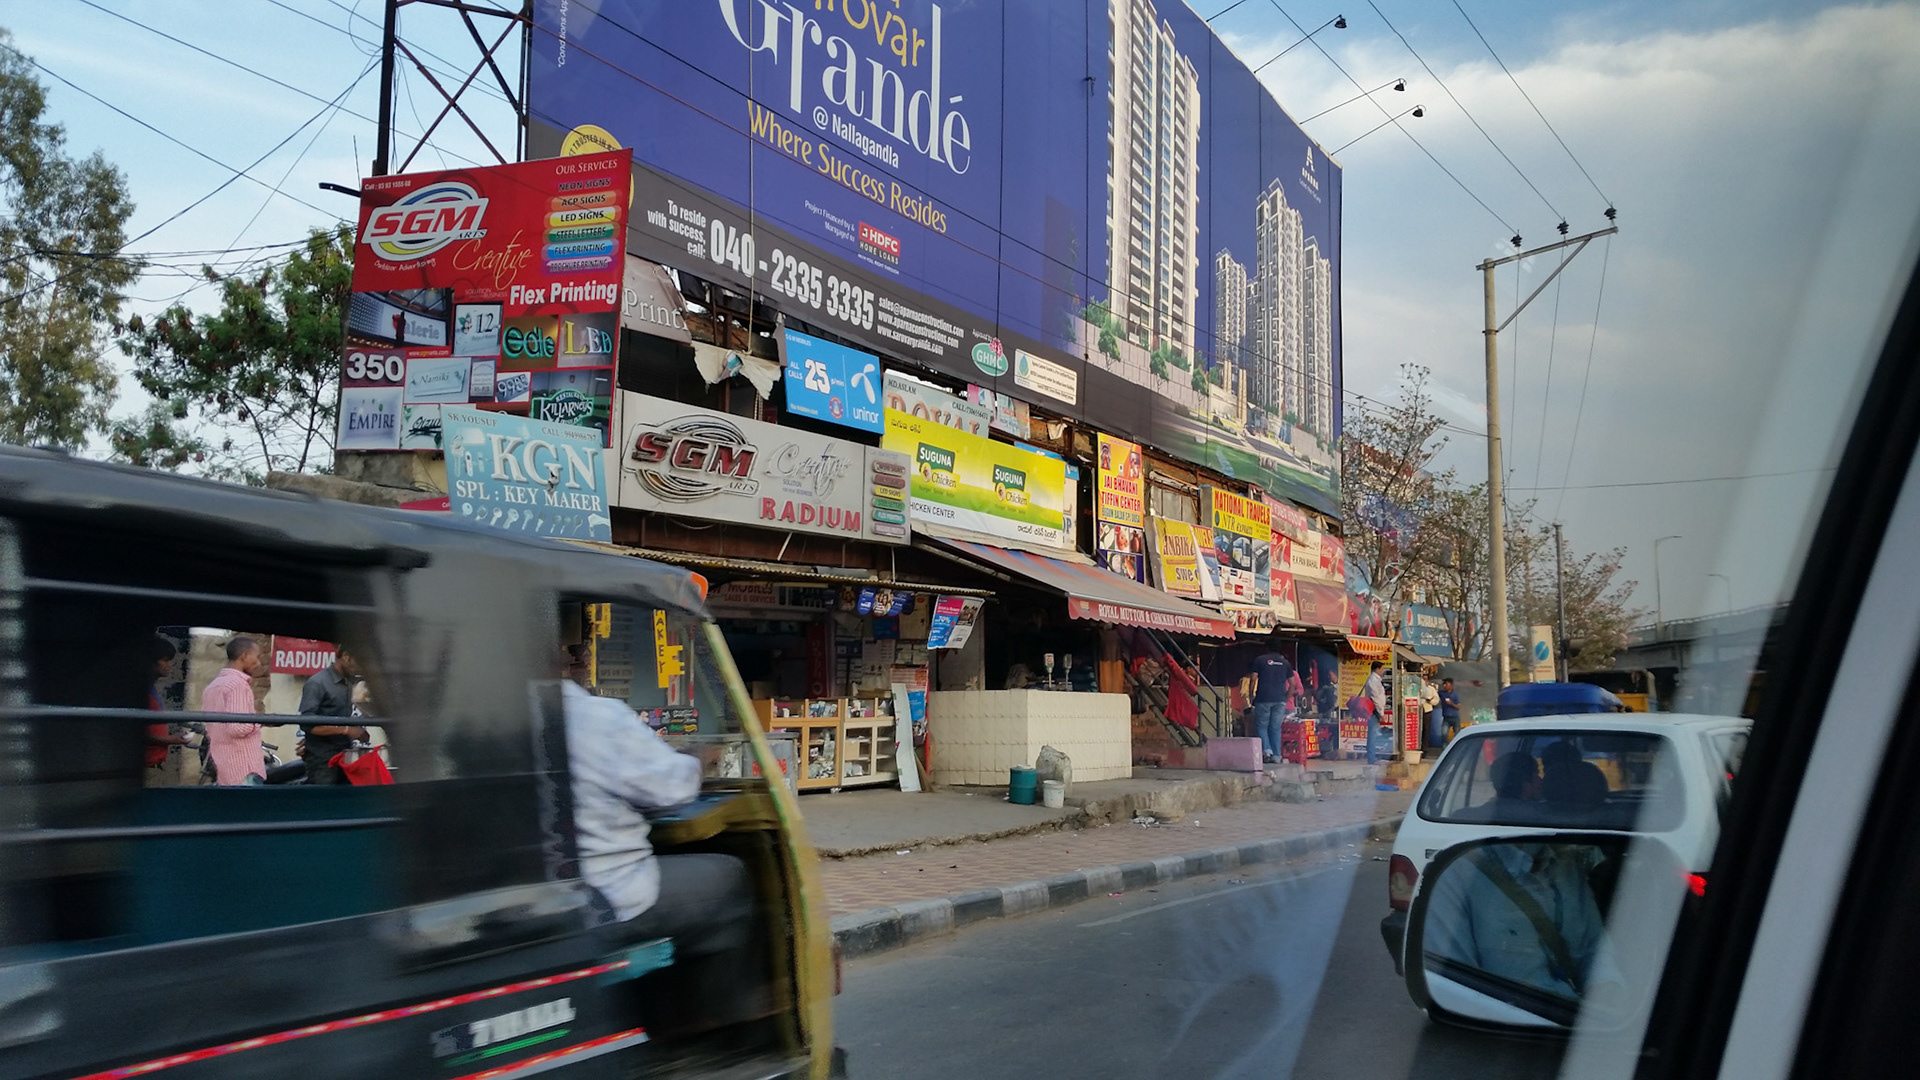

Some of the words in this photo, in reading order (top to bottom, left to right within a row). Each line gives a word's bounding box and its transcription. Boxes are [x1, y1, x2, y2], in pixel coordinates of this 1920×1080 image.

[812, 105, 829, 129] @
[831, 114, 899, 169] Nallagandla
[555, 165, 576, 175] OUR
[578, 159, 618, 173] SERVICES
[747, 99, 812, 165] Where
[817, 143, 885, 204] Success
[891, 182, 947, 234] Resides
[558, 182, 583, 191] NEON
[584, 178, 611, 189] SIGNS
[562, 197, 579, 206] ACP
[580, 195, 606, 204] SIGNS
[371, 205, 480, 238] SGM
[560, 213, 577, 222] LED
[578, 211, 604, 220] SIGNS
[667, 199, 678, 217] To
[679, 206, 706, 228] reside
[804, 199, 822, 217] Project
[823, 209, 843, 227] Financed
[556, 230, 576, 240] STEEL
[576, 227, 606, 238] LETTERS
[647, 209, 667, 229] with
[668, 218, 706, 246] success,
[554, 246, 571, 255] FLEX
[572, 243, 606, 253] PRINTING
[687, 242, 706, 259] call:
[869, 228, 899, 253] HDFC
[452, 230, 533, 290] Creative
[859, 241, 877, 256] HOME
[879, 250, 899, 265] LOANS
[710, 219, 756, 278] 040
[771, 249, 823, 310] 2335
[827, 275, 875, 331] 3335
[509, 284, 546, 305] Flex
[549, 281, 618, 305] Printing
[878, 296, 964, 338] sales@aparnaconstructions.com
[564, 320, 613, 354] LED
[878, 310, 959, 349] www.aparnaconstructions.com
[346, 352, 404, 382] 350
[790, 360, 800, 370] ALL
[976, 349, 1003, 370] GHMC
[787, 369, 803, 380] CALLS
[804, 358, 831, 395] 25
[349, 410, 396, 431] EMPIRE
[852, 406, 879, 424] uninor
[487, 432, 599, 492] KGN
[631, 431, 756, 478] SGM
[919, 446, 952, 467] SUGUNA
[726, 481, 756, 492] ARTS
[932, 471, 957, 488] Chicken
[995, 468, 1023, 486] SUGUNA
[1104, 475, 1113, 490] JAI
[1113, 477, 1138, 496] BHAVANI
[456, 479, 491, 501] SPL
[504, 484, 539, 505] KEY
[544, 489, 602, 513] MAKER
[1005, 491, 1028, 506] Chicken
[1101, 491, 1119, 508] TIFFIN
[1120, 495, 1141, 513] CENTER
[1215, 490, 1245, 518] NATIONAL
[1246, 500, 1270, 526] TRAVELS
[762, 497, 861, 532] RADIUM
[932, 506, 955, 519] CENTER
[1098, 603, 1119, 619] ROYAL
[1119, 606, 1144, 622] MUTTON
[1145, 610, 1151, 623] &
[1150, 611, 1175, 627] CHICKEN
[1175, 615, 1197, 630] CENTER
[275, 650, 336, 669] RADIUM
